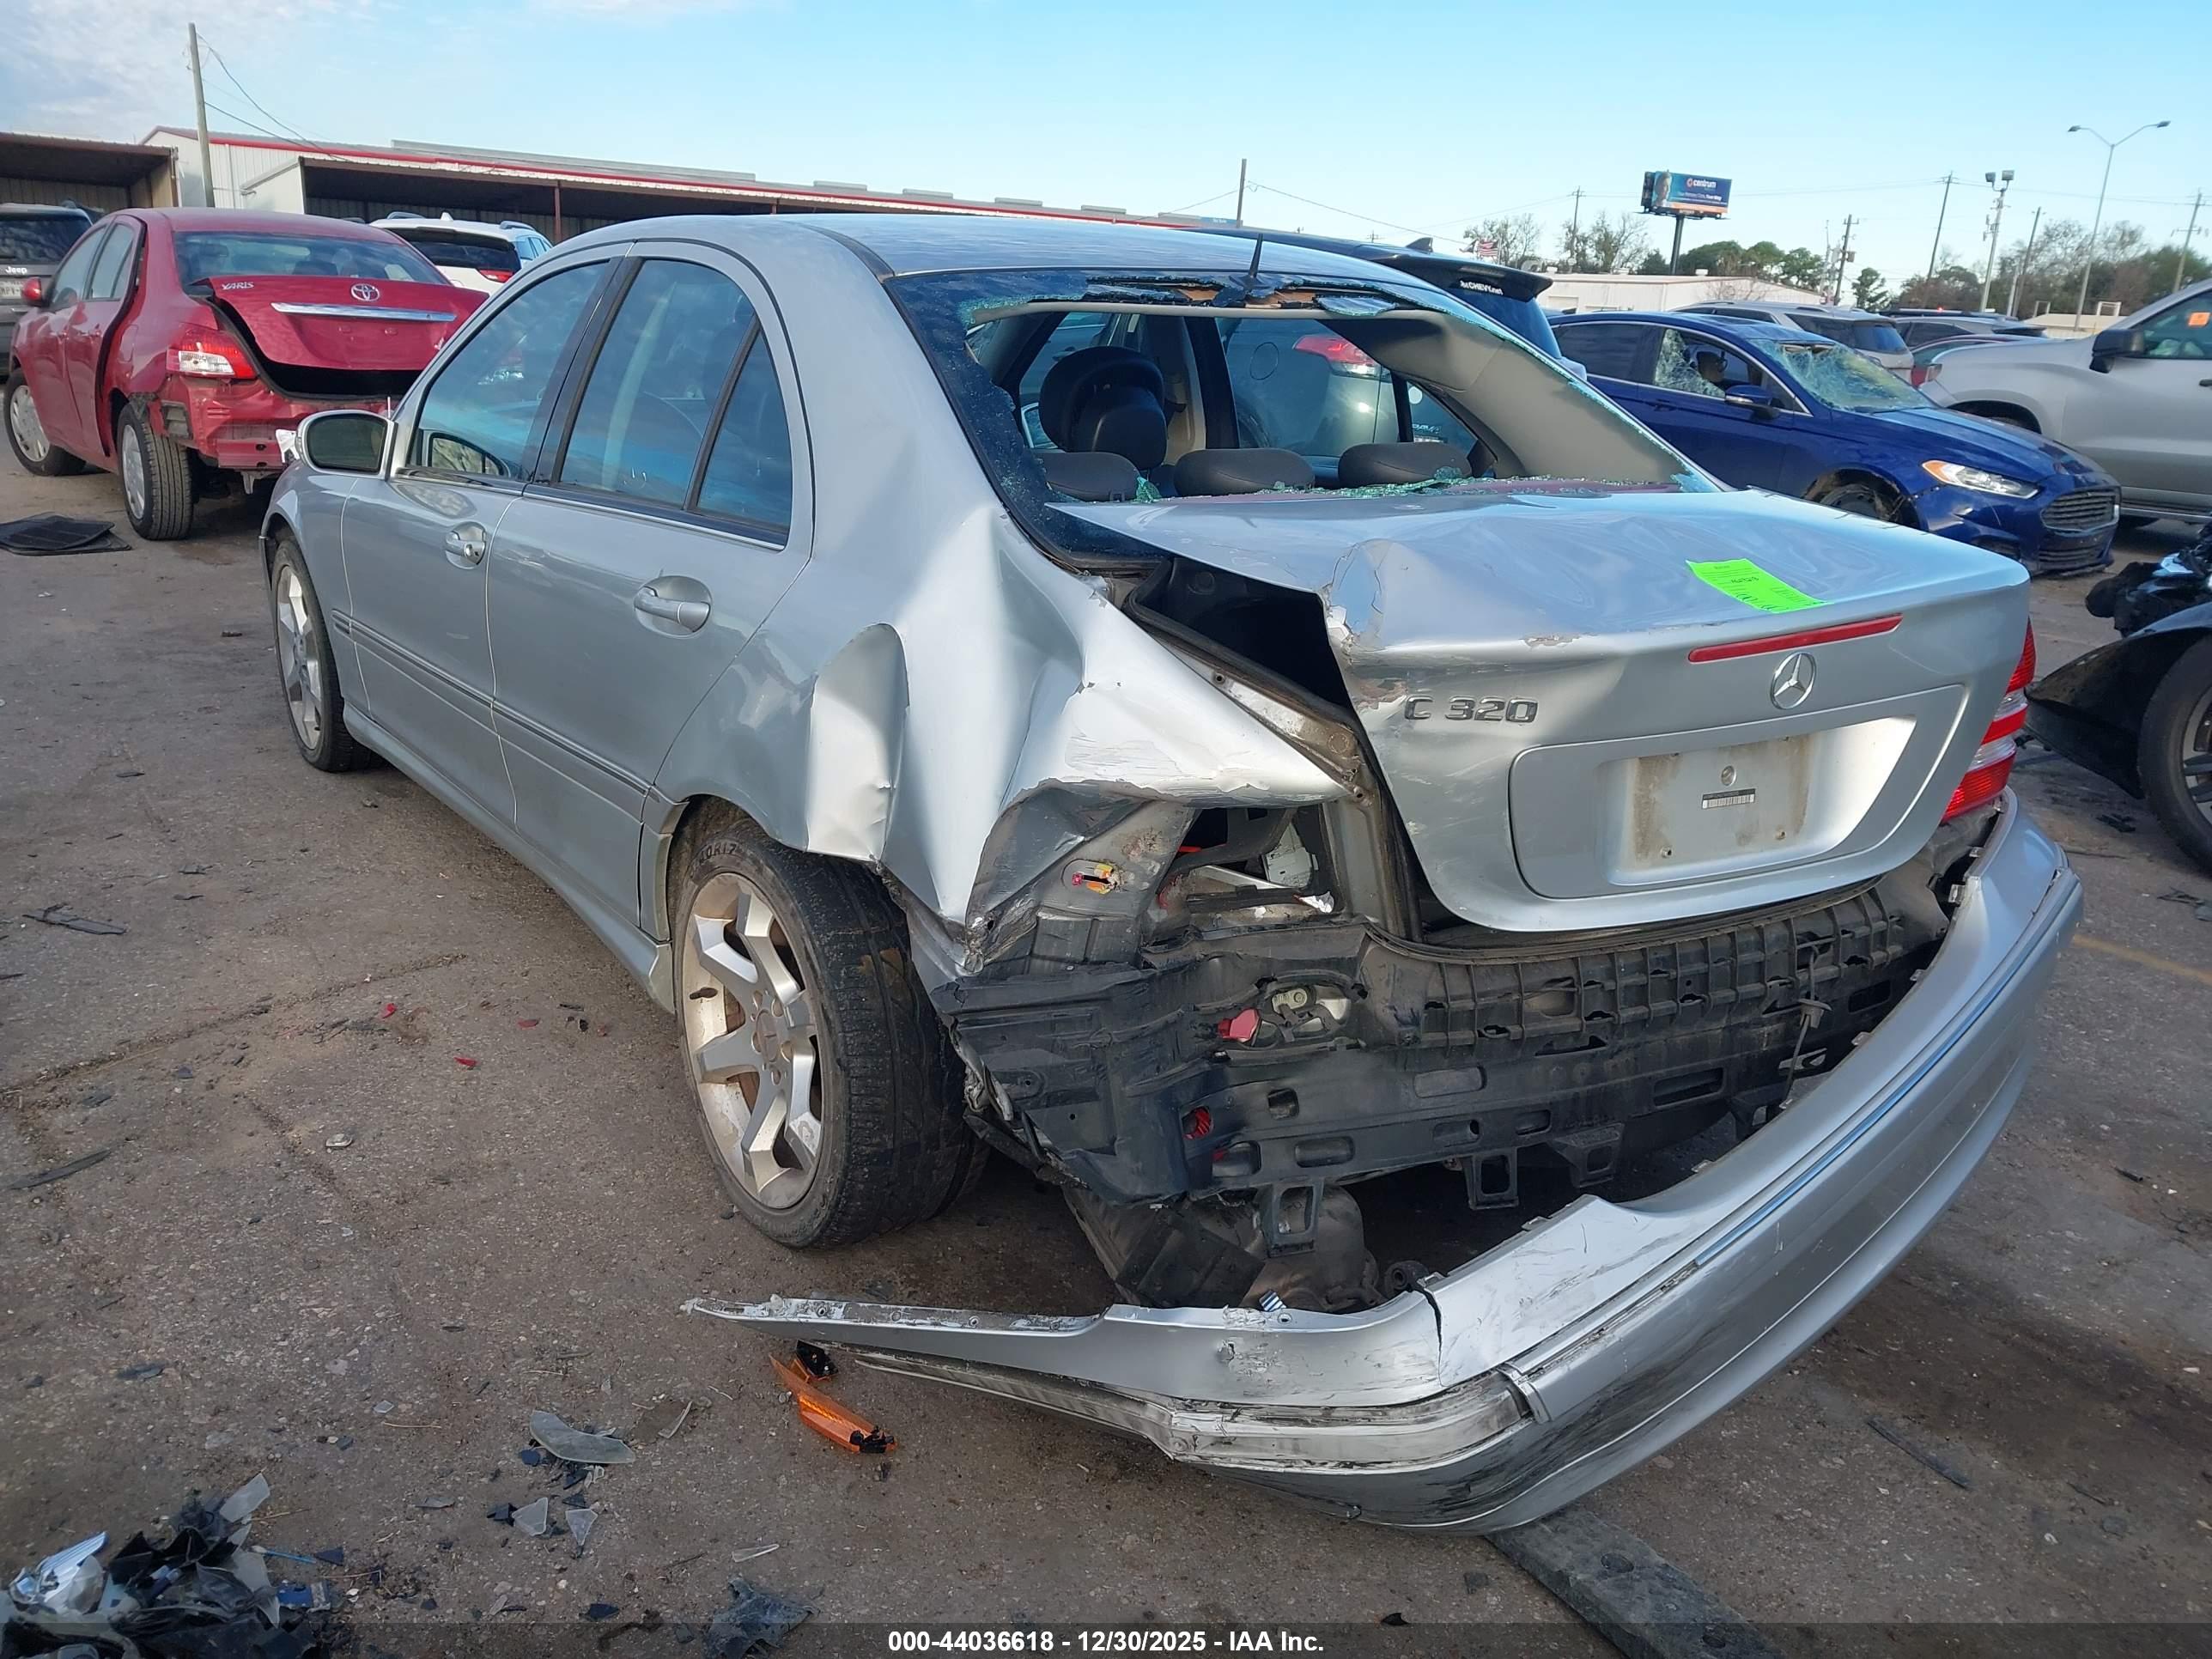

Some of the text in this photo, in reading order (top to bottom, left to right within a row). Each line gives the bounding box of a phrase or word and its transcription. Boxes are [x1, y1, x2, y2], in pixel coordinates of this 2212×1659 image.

[5, 265, 27, 275] Jeep
[222, 281, 255, 290] YARIS
[1404, 695, 1540, 724] C 320
